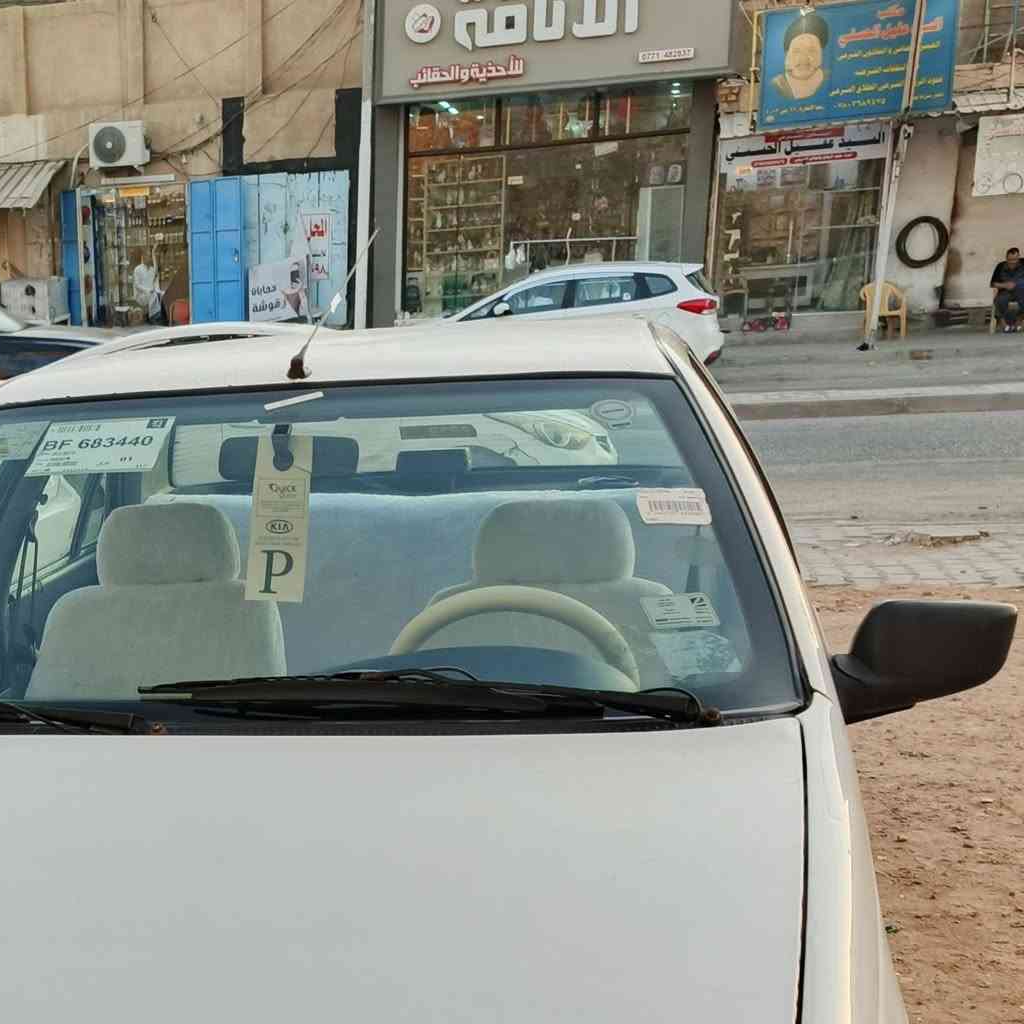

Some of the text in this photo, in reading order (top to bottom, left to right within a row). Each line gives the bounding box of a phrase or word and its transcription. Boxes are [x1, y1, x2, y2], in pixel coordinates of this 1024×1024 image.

[410, 54, 524, 88] للأحذية والحقائب
[43, 439, 73, 451] BF
[78, 435, 153, 449] 683440
[270, 523, 289, 531] KIA
[258, 549, 294, 593] P
